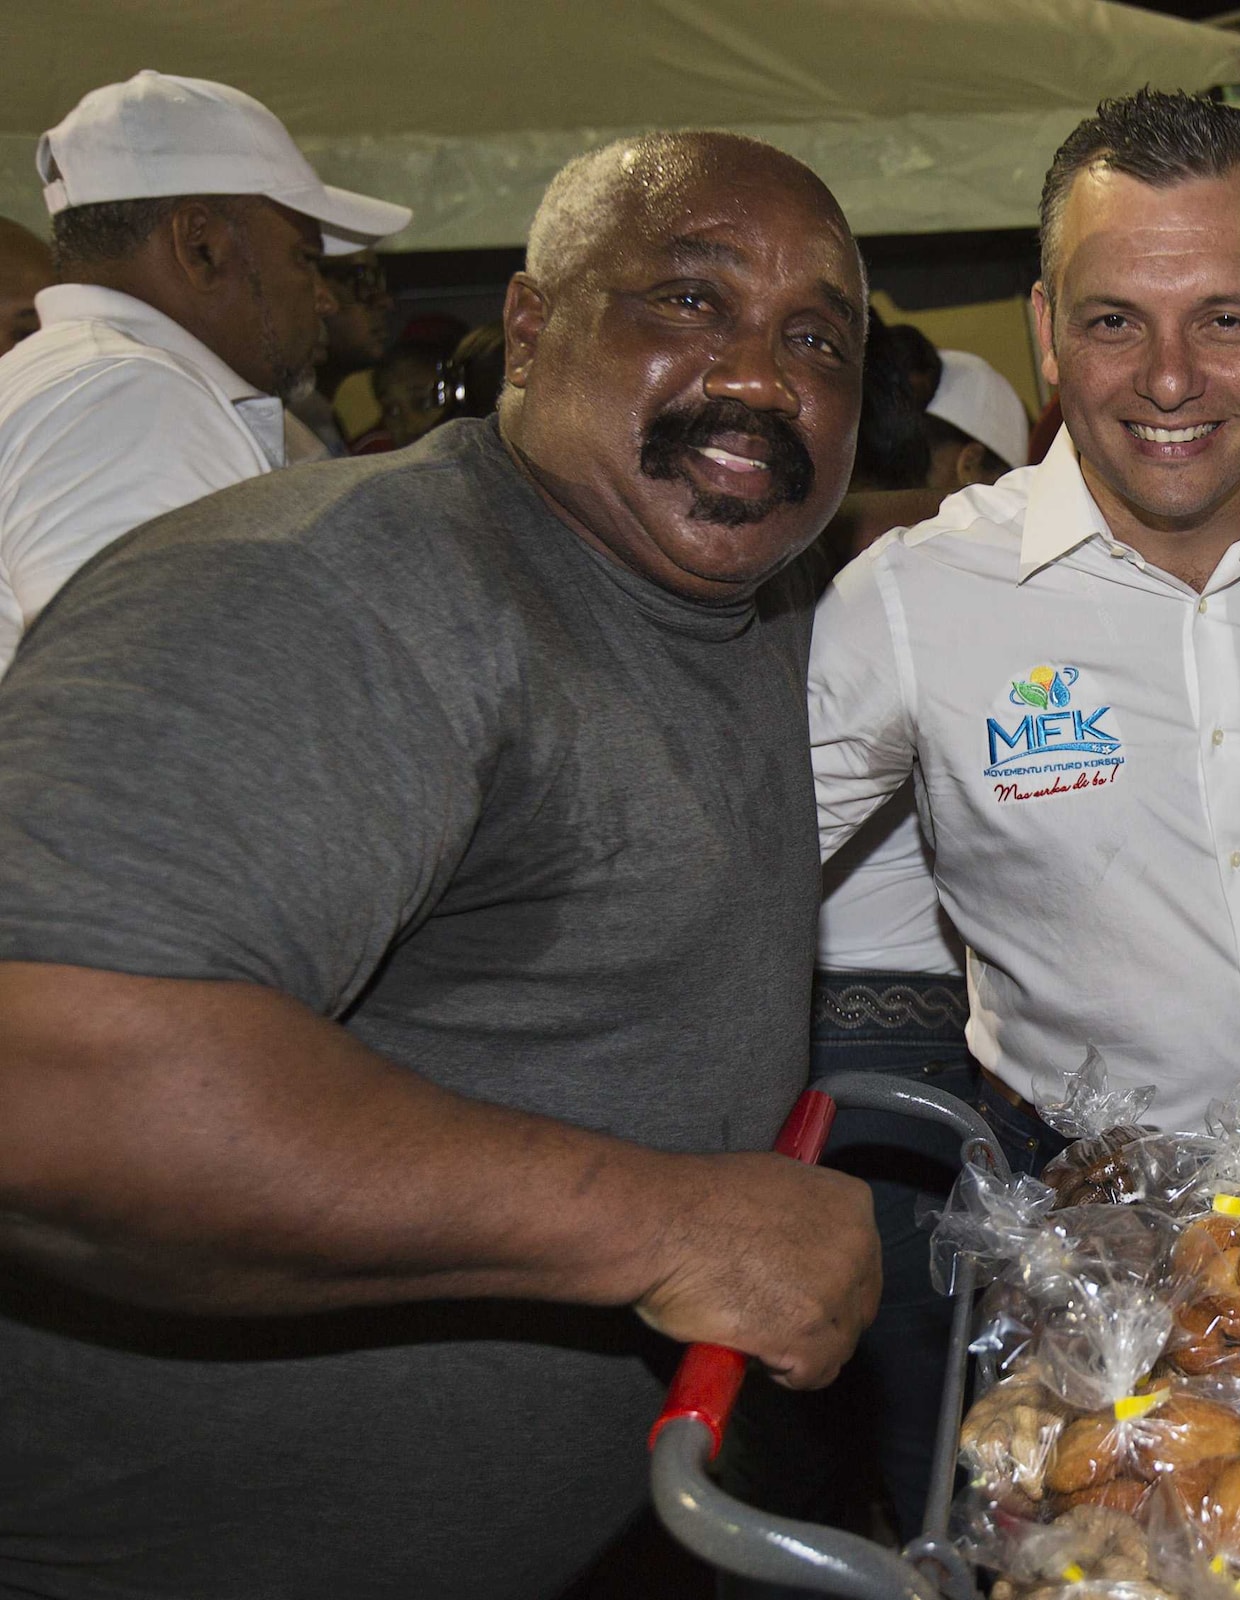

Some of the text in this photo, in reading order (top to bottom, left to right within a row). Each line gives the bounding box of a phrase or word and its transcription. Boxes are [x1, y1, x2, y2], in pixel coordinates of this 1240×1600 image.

[986, 706, 1120, 765] MFK
[983, 756, 1125, 778] MOVEMENTU FUTURO KORSOU
[993, 783, 1033, 802] Mas
